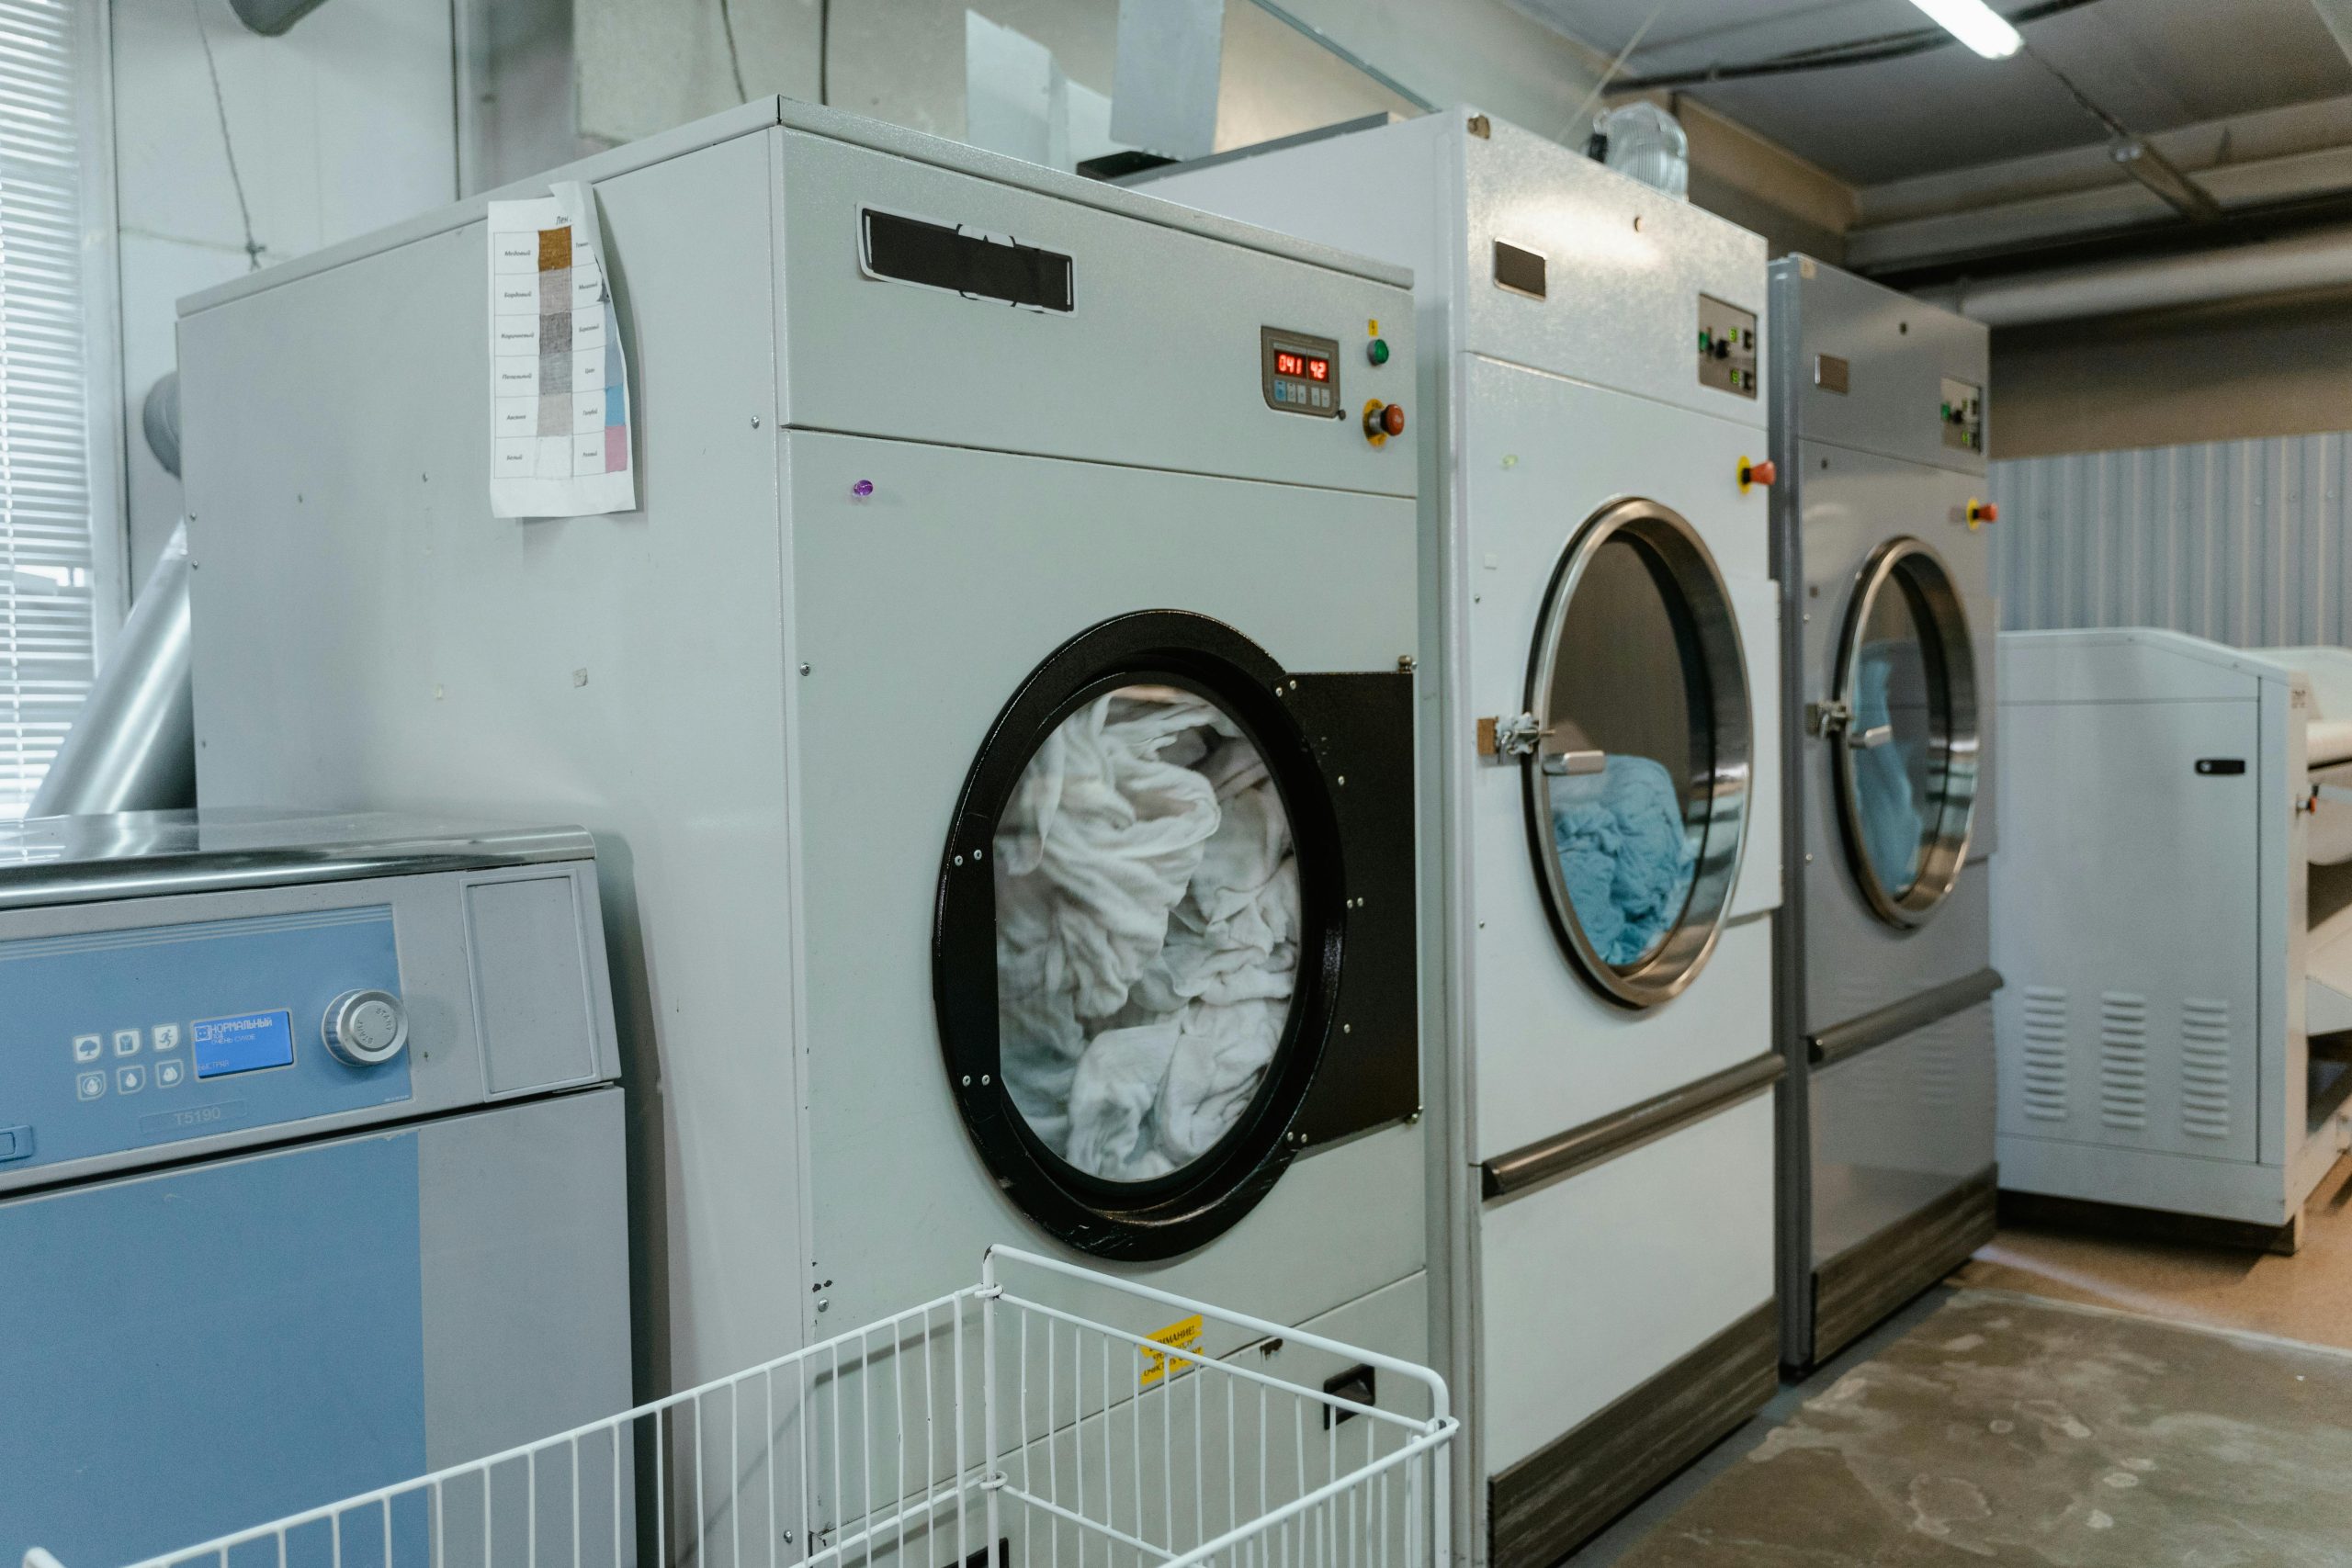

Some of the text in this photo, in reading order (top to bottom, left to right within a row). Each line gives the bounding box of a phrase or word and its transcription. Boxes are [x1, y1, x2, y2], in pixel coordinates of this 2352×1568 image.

[1278, 354, 1303, 375] 041
[1310, 360, 1328, 379] 42
[175, 1106, 220, 1125] T5190
